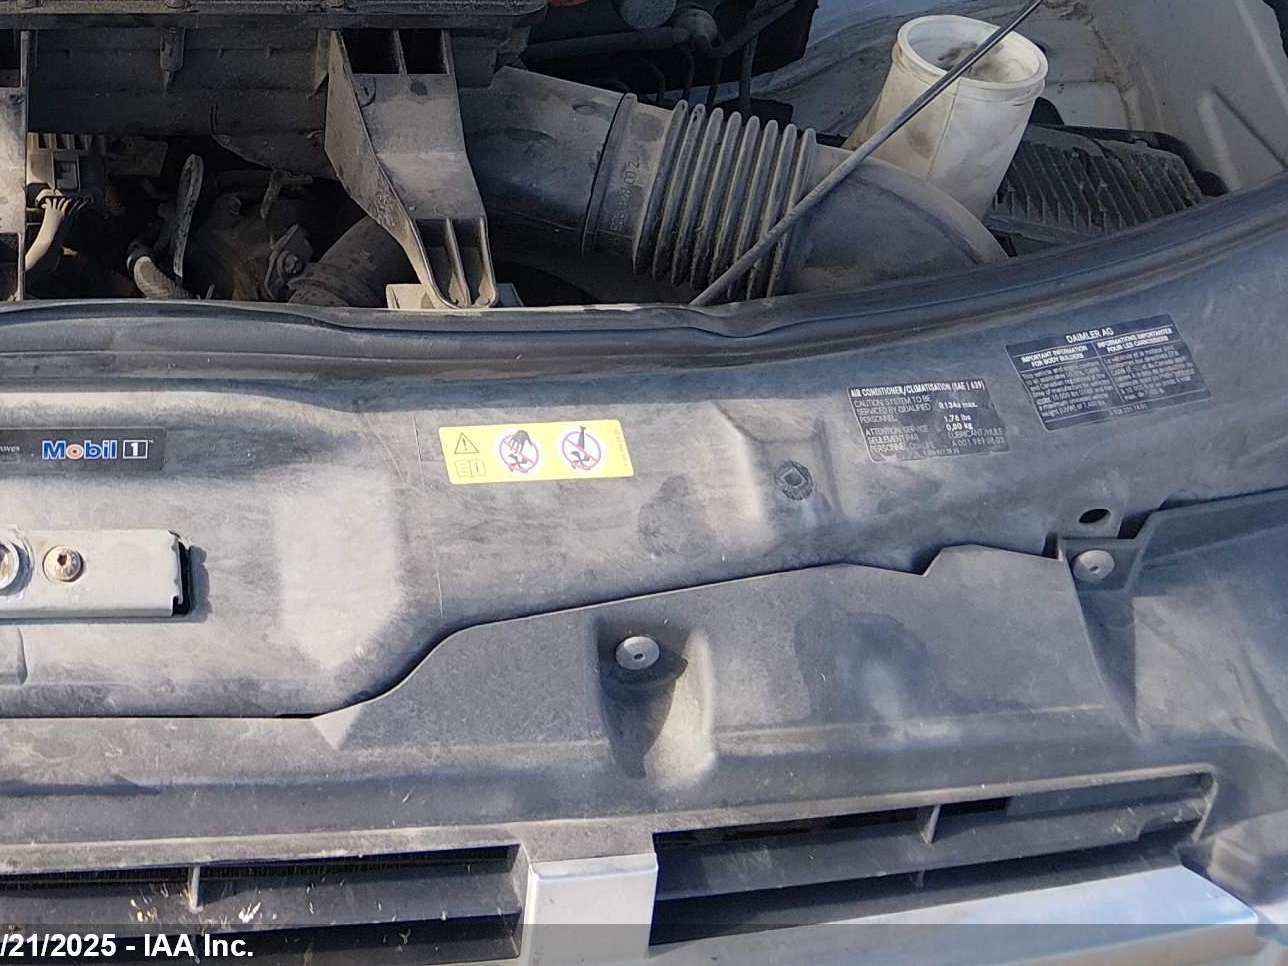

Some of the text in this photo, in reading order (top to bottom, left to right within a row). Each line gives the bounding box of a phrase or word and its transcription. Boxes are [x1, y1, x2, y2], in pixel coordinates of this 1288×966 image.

[1065, 327, 1114, 344] DAIMLER AG
[1031, 360, 1043, 368] FOR
[1043, 356, 1059, 365] BODY
[850, 388, 862, 397] AIR
[41, 439, 118, 460] Mobil
